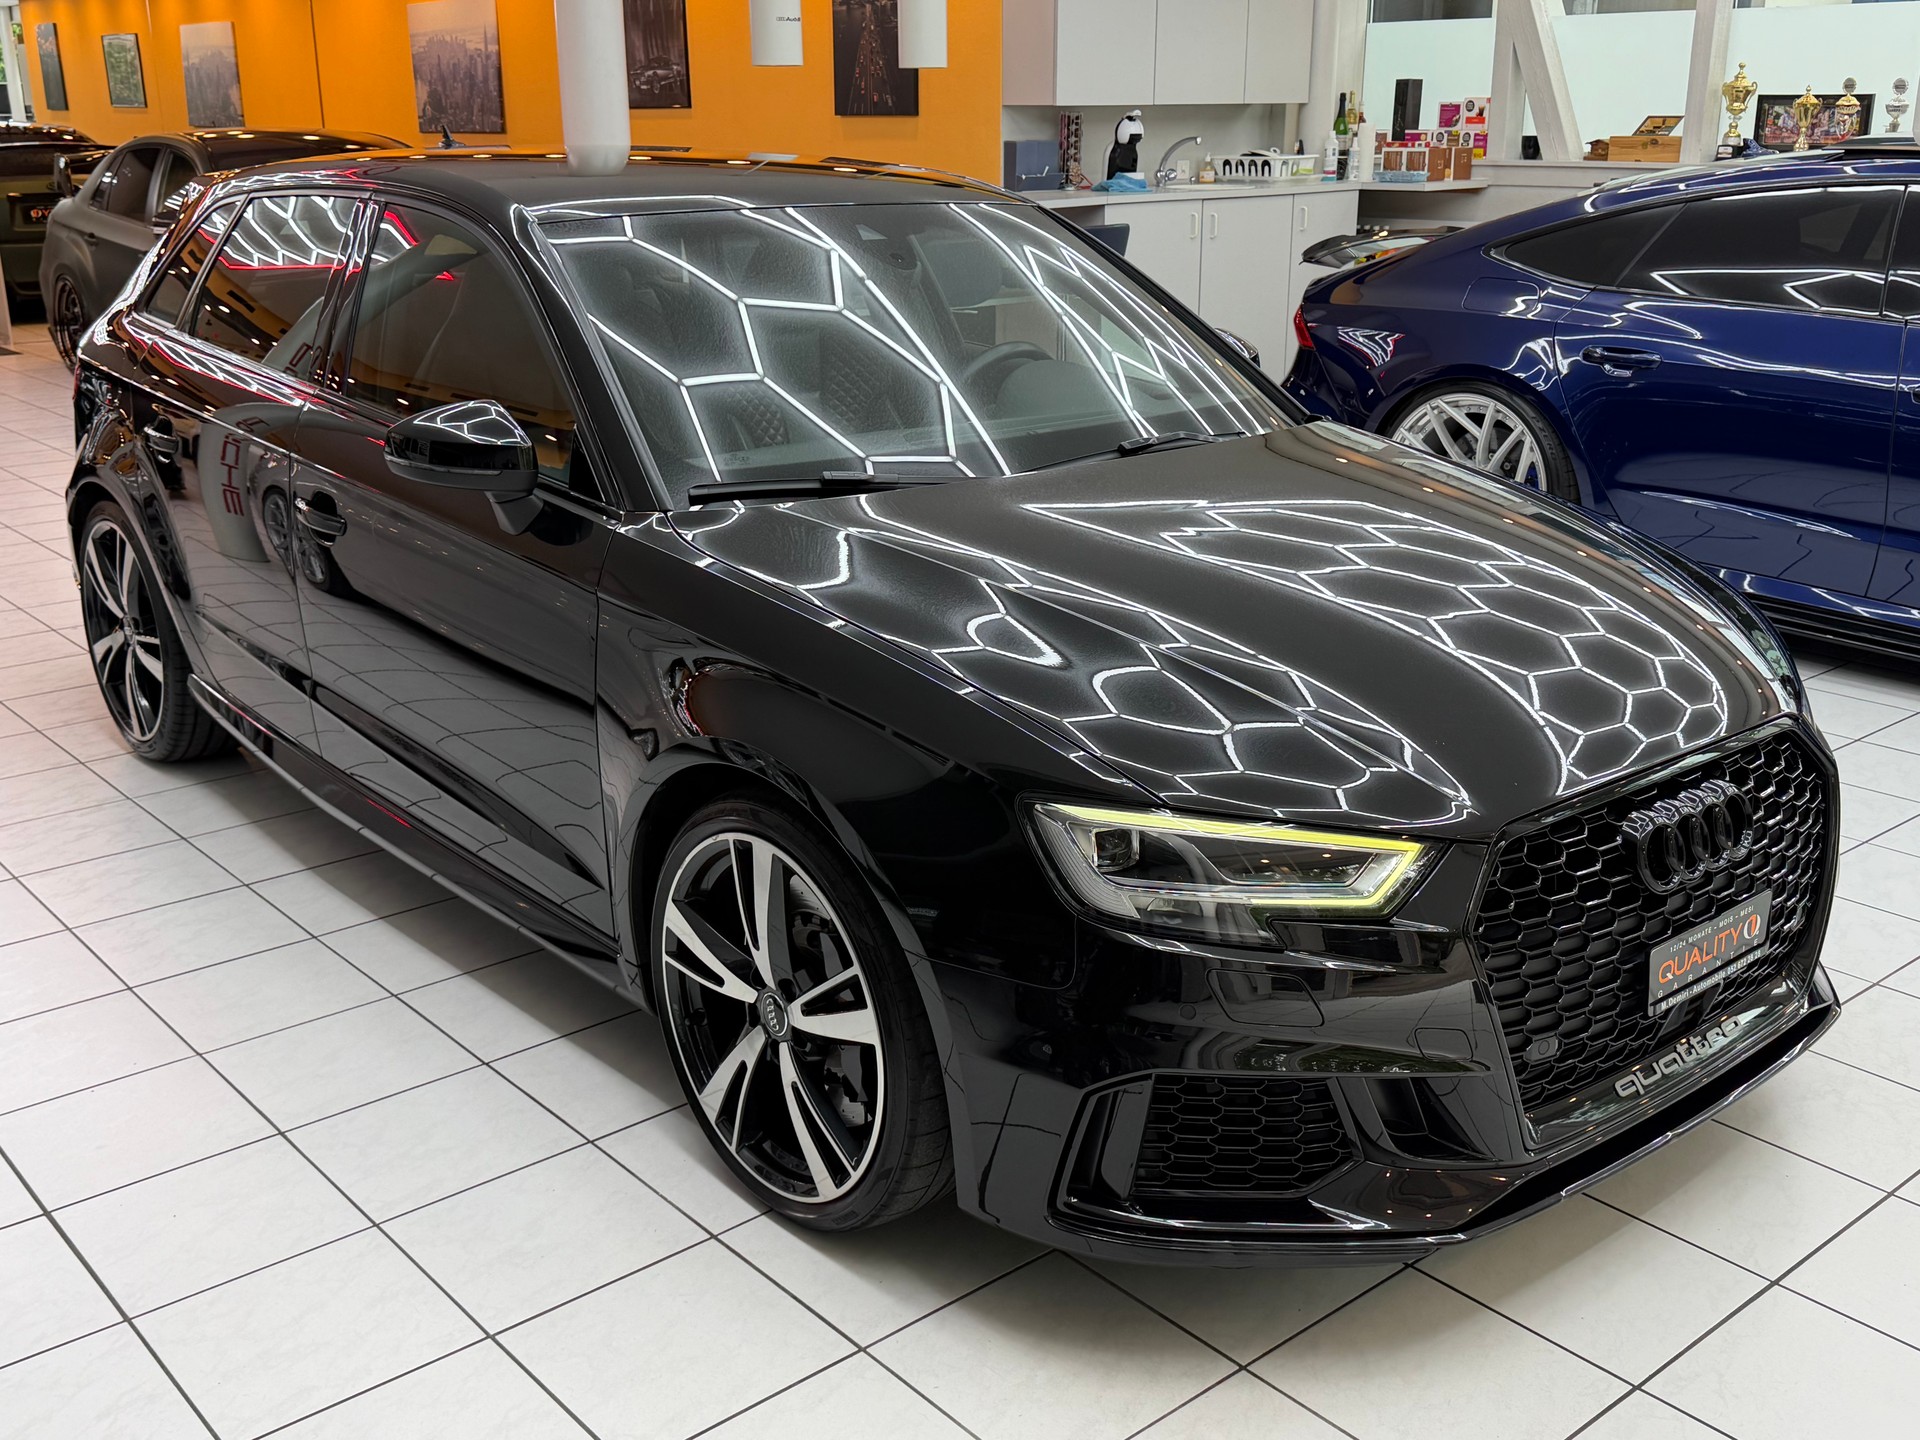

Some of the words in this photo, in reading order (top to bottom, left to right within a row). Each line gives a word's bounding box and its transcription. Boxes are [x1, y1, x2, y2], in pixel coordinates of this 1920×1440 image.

[1658, 922, 1744, 984] QUALITY
[1688, 926, 1712, 944] MONATE
[1719, 915, 1734, 928] MOIS
[1740, 905, 1754, 917] MESI
[1657, 938, 1758, 999] GARANTIE
[1613, 1015, 1742, 1098] quattro
